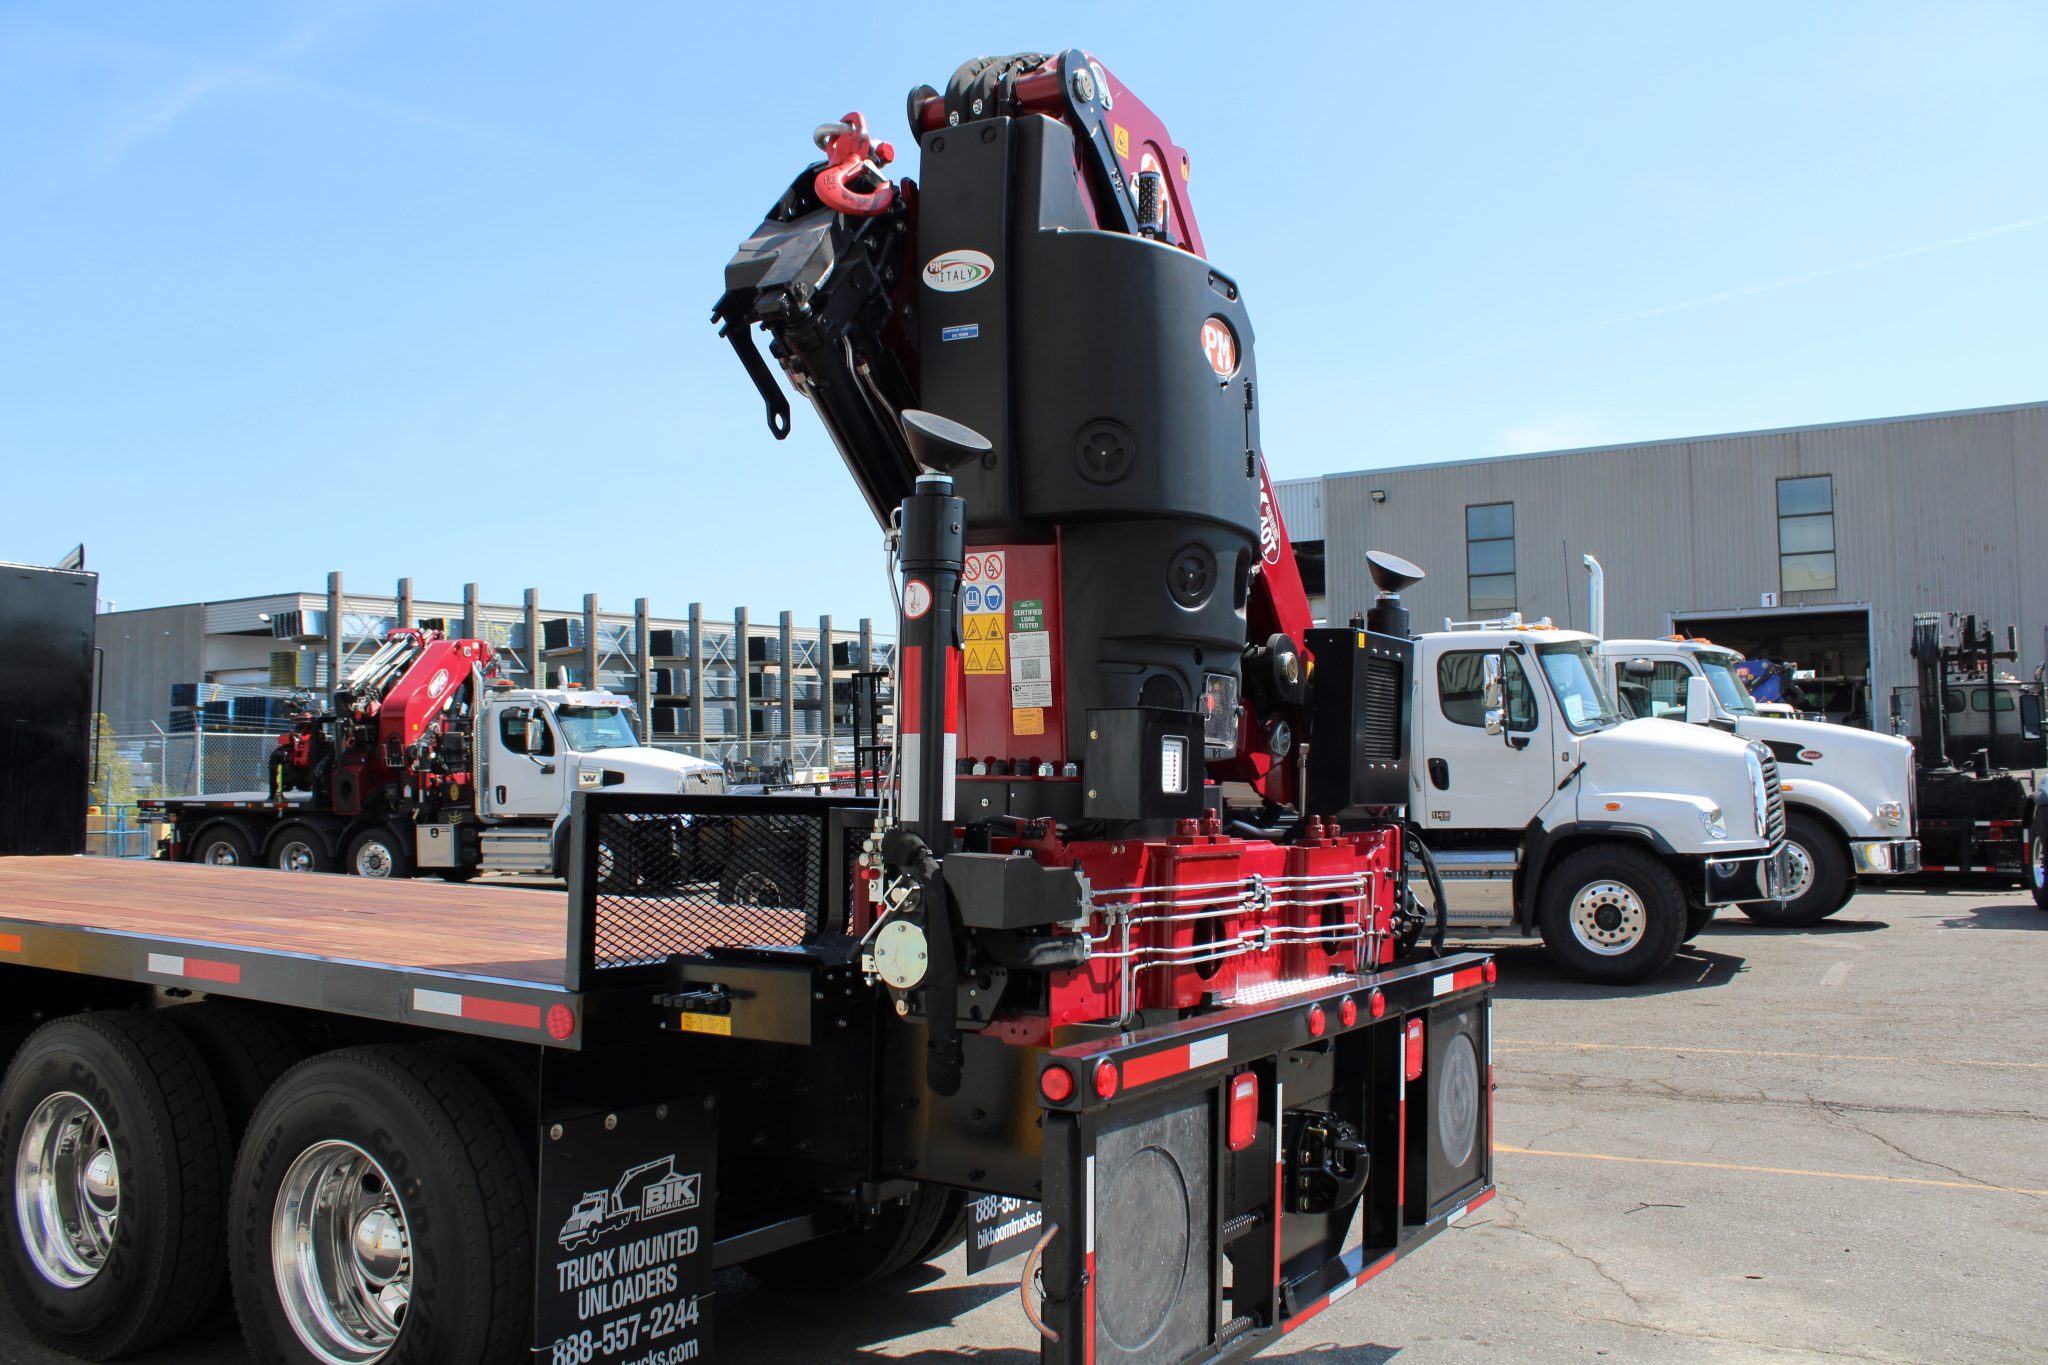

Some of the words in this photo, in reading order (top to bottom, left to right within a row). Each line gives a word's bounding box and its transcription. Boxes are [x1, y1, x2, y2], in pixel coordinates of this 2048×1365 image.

[940, 268, 972, 282] ITALY
[1204, 325, 1231, 370] PM
[1766, 594, 1772, 606] 1
[645, 1197, 696, 1216] HYDRAULICS
[647, 1178, 696, 1208] BIK
[556, 1248, 615, 1293] TRUCK
[618, 1225, 699, 1275] MOUNTED
[578, 1263, 678, 1320] UNLOADERS
[552, 1294, 699, 1365] 888-557-2244
